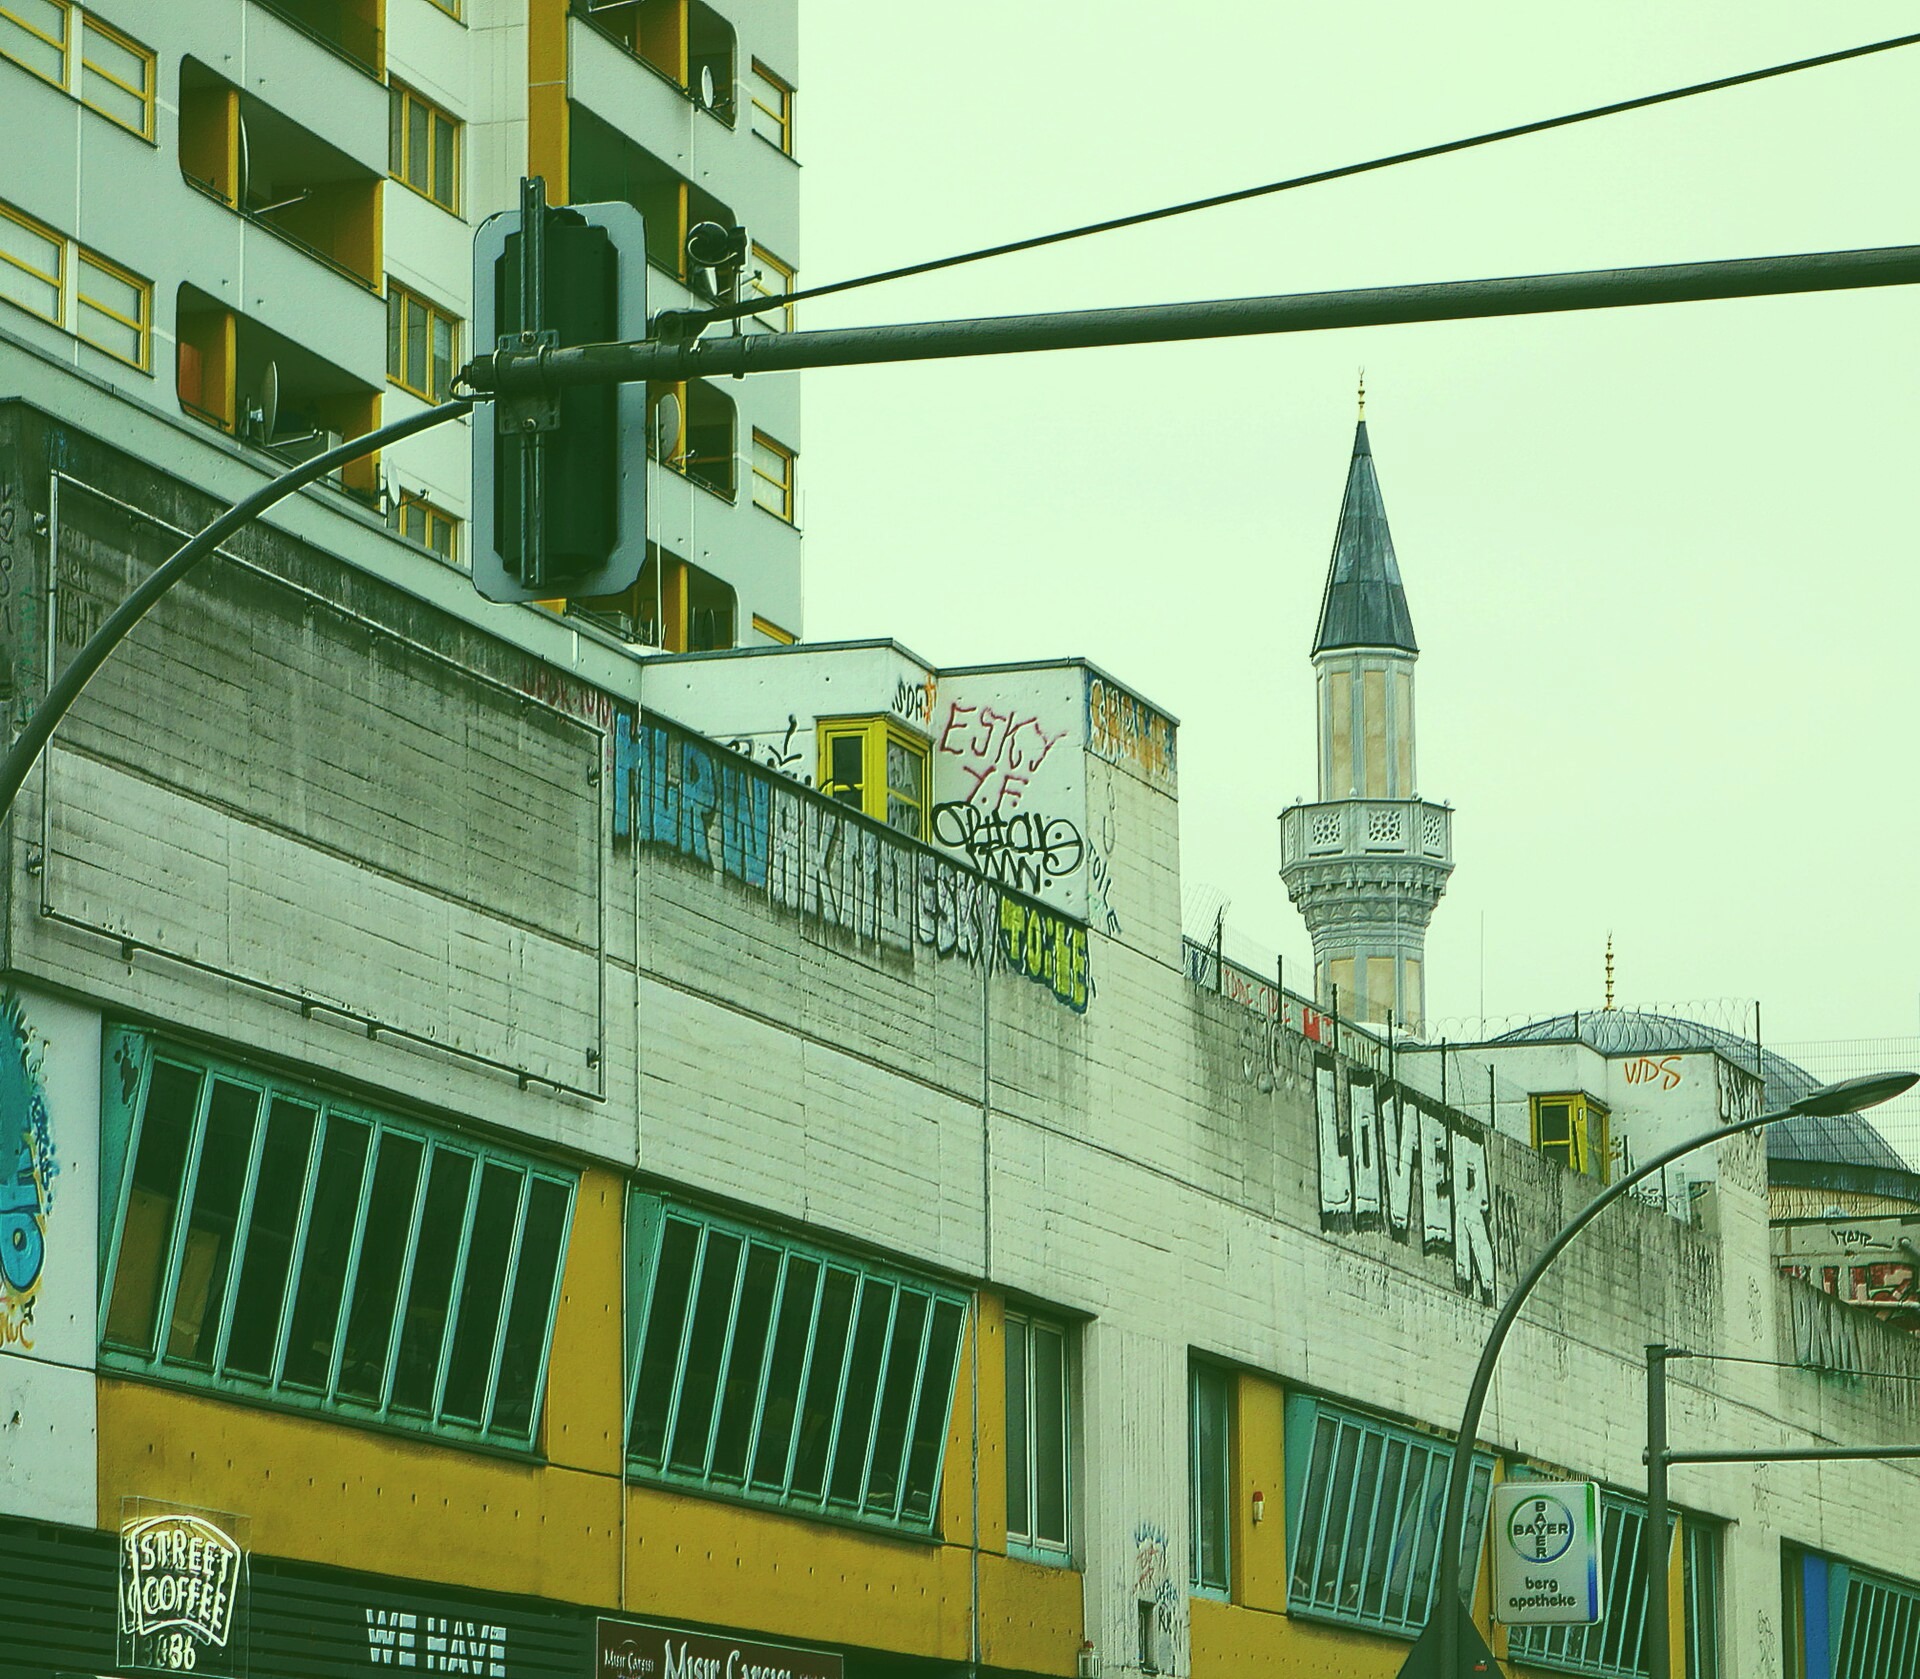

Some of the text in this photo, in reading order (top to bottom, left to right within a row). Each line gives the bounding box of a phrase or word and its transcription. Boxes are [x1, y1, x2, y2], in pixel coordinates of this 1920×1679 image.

[939, 702, 1067, 773] ESKY
[1314, 1050, 1498, 1310] LOVER
[140, 1529, 233, 1583] STREET
[1513, 1522, 1569, 1536] BAYER
[142, 1575, 227, 1631] COFFEE
[1509, 1594, 1577, 1611] apotheke
[1526, 1576, 1559, 1593] berg
[366, 1608, 507, 1678] WE HAVE
